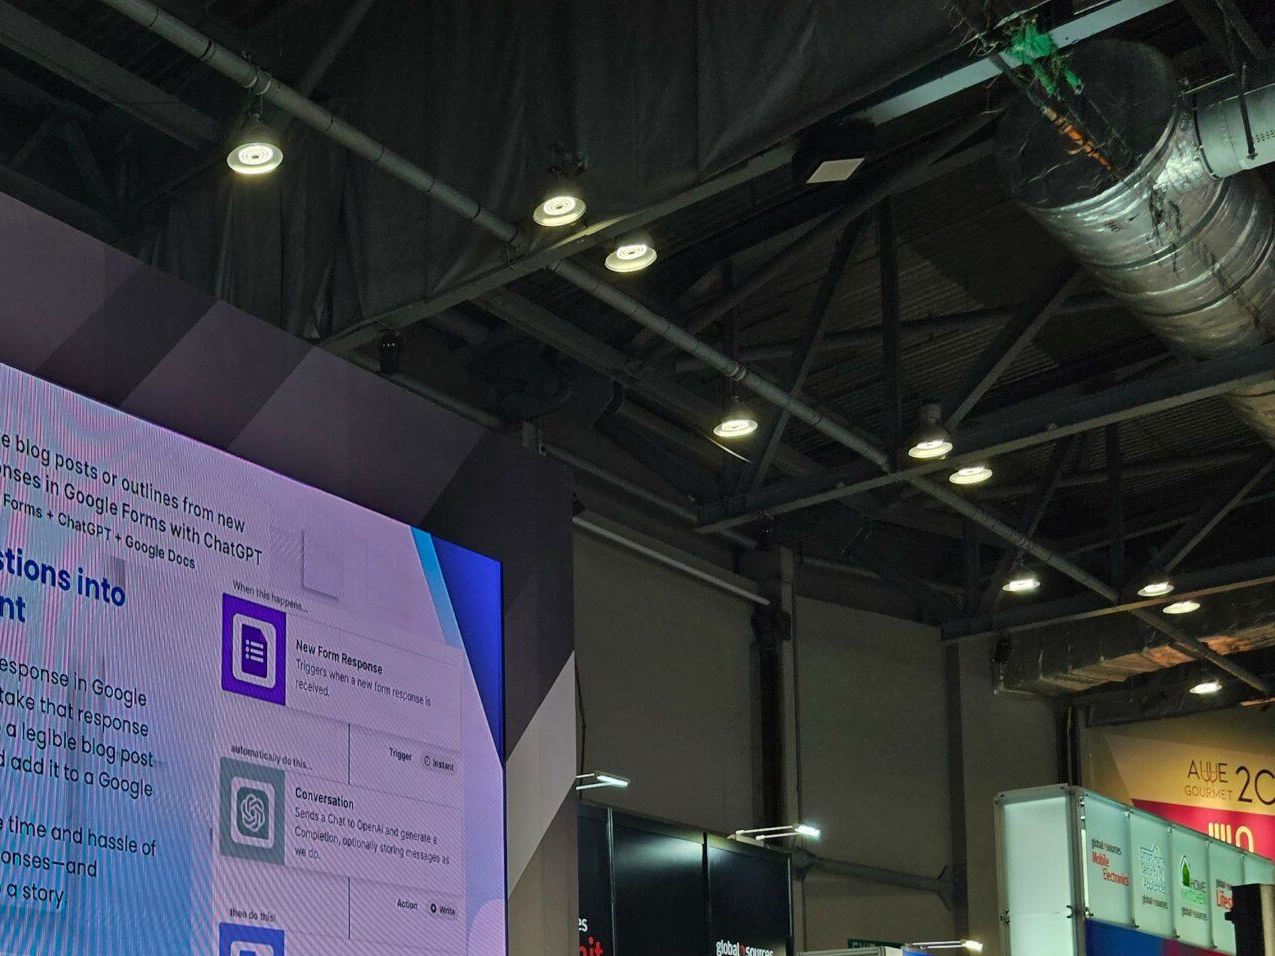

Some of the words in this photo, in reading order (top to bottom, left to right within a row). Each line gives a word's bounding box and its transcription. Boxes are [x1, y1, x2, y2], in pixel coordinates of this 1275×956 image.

[15, 433, 50, 469] blog
[55, 450, 98, 485] posts
[101, 469, 118, 490] or
[121, 473, 179, 512] outlines
[182, 495, 214, 524] from
[217, 510, 245, 535] new
[2, 492, 42, 520] Forms
[46, 509, 54, 521] +
[57, 511, 111, 544] ChatGPT
[115, 531, 122, 544] +
[125, 533, 165, 563] Google
[167, 547, 195, 571] Docs
[44, 475, 59, 497] in
[63, 481, 118, 521] Google
[121, 501, 166, 534] Forms
[169, 517, 200, 546] with
[203, 530, 262, 567] ChatGPT
[76, 565, 126, 609] into
[295, 638, 315, 656] New
[317, 645, 339, 663] Form
[341, 652, 382, 678] Response
[73, 671, 87, 693] in
[91, 677, 146, 713] Google
[294, 676, 330, 698] received.
[295, 657, 327, 680] Triggers
[328, 667, 349, 684] when
[350, 676, 356, 686] a
[357, 678, 372, 691] new
[374, 680, 390, 696] form
[391, 688, 423, 708] response
[424, 695, 430, 708] is
[39, 695, 74, 721] that
[77, 707, 149, 742] response
[5, 722, 16, 739] a
[81, 735, 116, 765] blog
[120, 744, 154, 774] post
[230, 742, 281, 766] automatically
[281, 754, 291, 766] do
[389, 746, 412, 763] Trigger
[432, 757, 454, 773] Instant
[10, 751, 44, 776] add
[48, 759, 59, 779] it
[63, 763, 79, 783] to
[83, 771, 94, 786] a
[98, 769, 153, 803] Google
[294, 785, 354, 810] Conversation
[1184, 784, 1233, 800] GOURMET
[8, 814, 47, 839] time
[50, 821, 83, 846] and
[87, 827, 138, 855] hassle
[141, 837, 156, 858] of
[294, 805, 319, 822] Sends
[320, 813, 325, 823] a
[327, 812, 345, 828] Chat
[347, 817, 355, 830] to
[356, 818, 383, 837] OpenAI
[385, 824, 398, 838] and
[400, 828, 431, 847] generate
[432, 836, 437, 847] a
[294, 824, 340, 847] Completion,
[342, 834, 378, 855] optionally
[379, 842, 404, 860] storing
[405, 848, 440, 867] messages
[441, 855, 449, 867] as
[1091, 851, 1110, 868] Mobile
[1103, 867, 1130, 887] Electronics
[6, 884, 17, 898] a
[22, 884, 67, 910] story.
[397, 897, 418, 911] Action
[439, 904, 455, 916] Write
